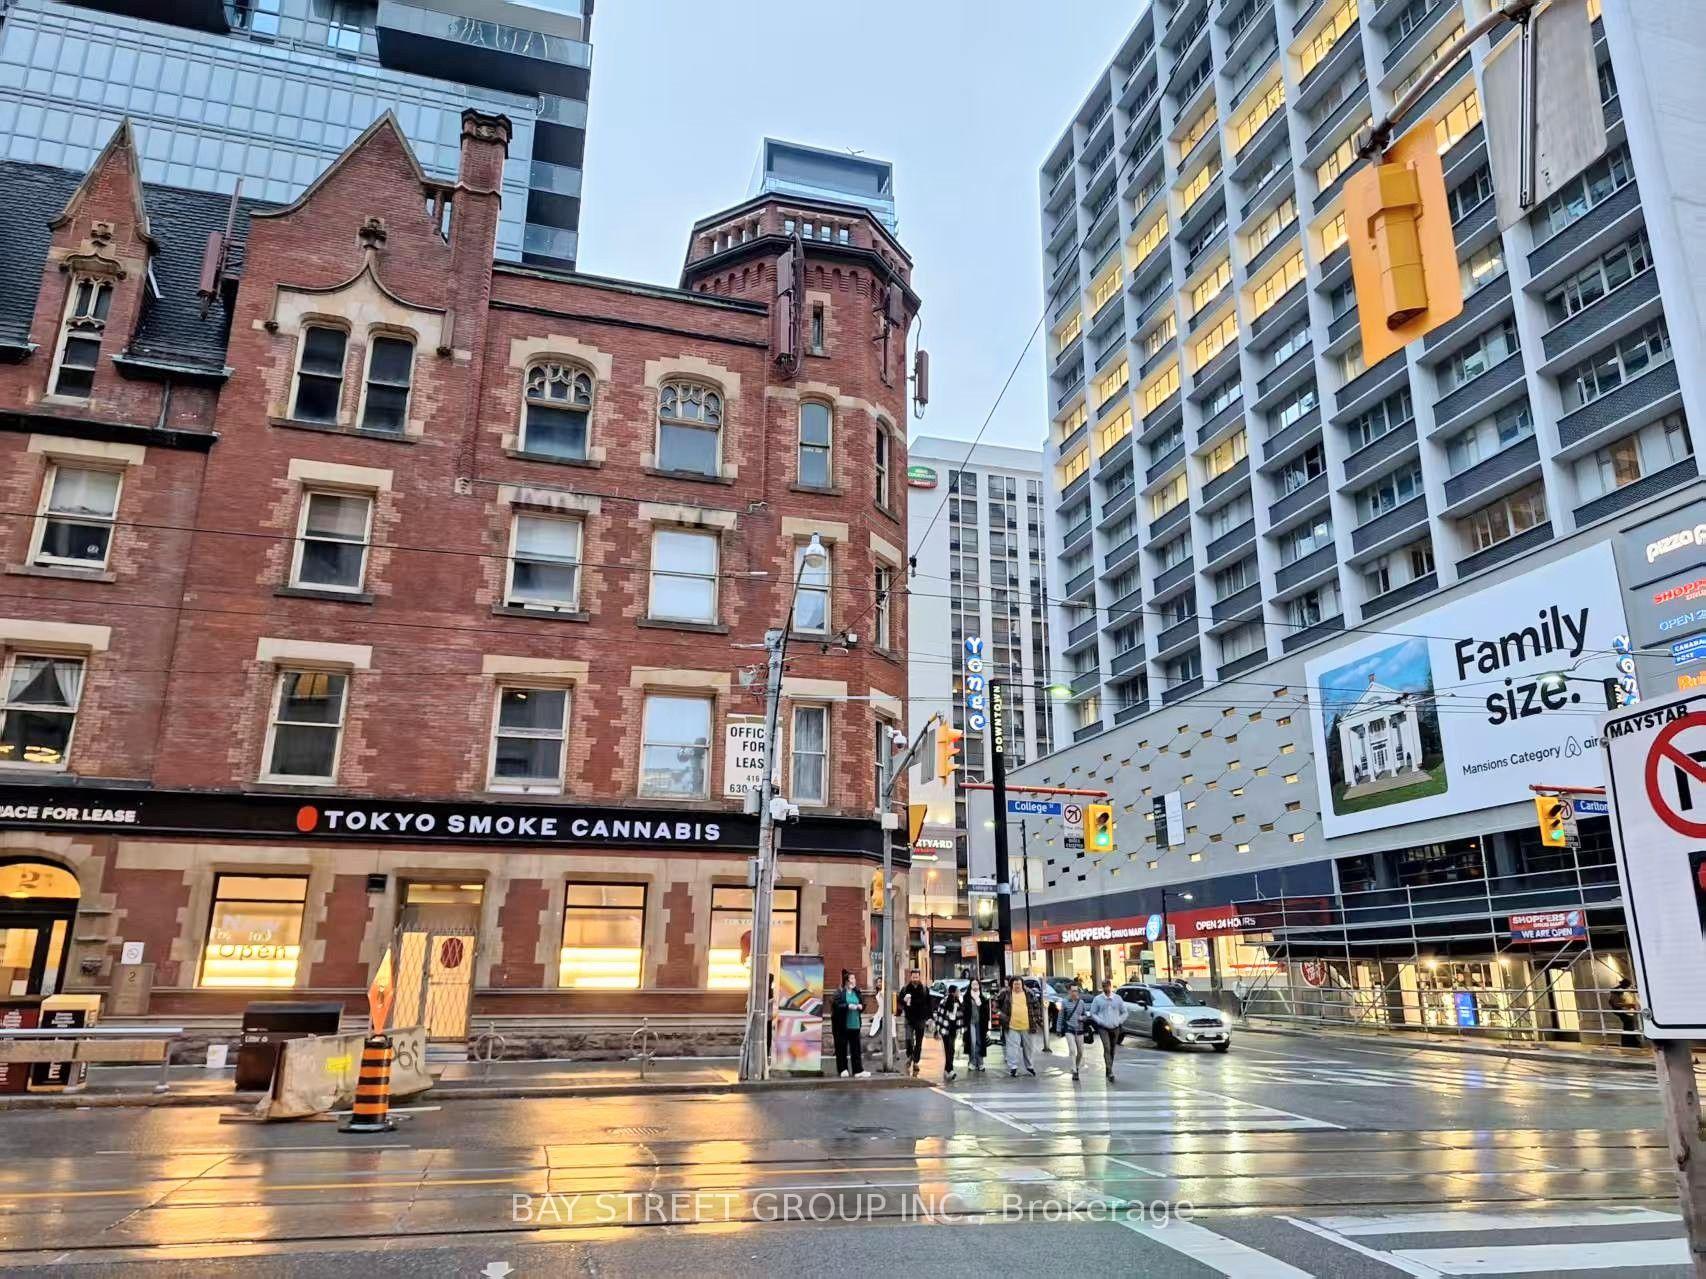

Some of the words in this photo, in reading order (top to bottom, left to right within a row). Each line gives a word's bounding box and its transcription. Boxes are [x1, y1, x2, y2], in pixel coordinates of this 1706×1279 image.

[1660, 613, 1694, 630] OPEN
[1455, 605, 1589, 681] Family
[967, 636, 986, 731] Yonge
[1486, 677, 1581, 725] size.
[993, 685, 1003, 752] DOWNTOWN
[1610, 704, 1689, 739] MAYSTAR
[730, 726, 764, 739] OFFIC
[742, 741, 765, 752] FOR
[1583, 735, 1600, 749] air
[736, 756, 764, 769] LEAS
[1463, 757, 1508, 775] Mansions
[1510, 746, 1561, 766] Category
[41, 807, 80, 820] FOR
[82, 809, 136, 822] LEASE
[1014, 801, 1048, 813] College
[324, 810, 436, 832] TOKYO
[447, 815, 558, 835] SMOKE
[571, 818, 720, 841] CANNABIS
[1196, 920, 1217, 930] OPEN
[1217, 919, 1227, 928] 24
[1512, 914, 1566, 924] SHOPPERS
[1061, 926, 1112, 943] SHOPPERS
[1111, 930, 1128, 938] DRUG
[1128, 927, 1146, 936] MART
[1521, 930, 1535, 938] WE
[1535, 929, 1550, 937] ARE
[1551, 928, 1573, 936] OPEN
